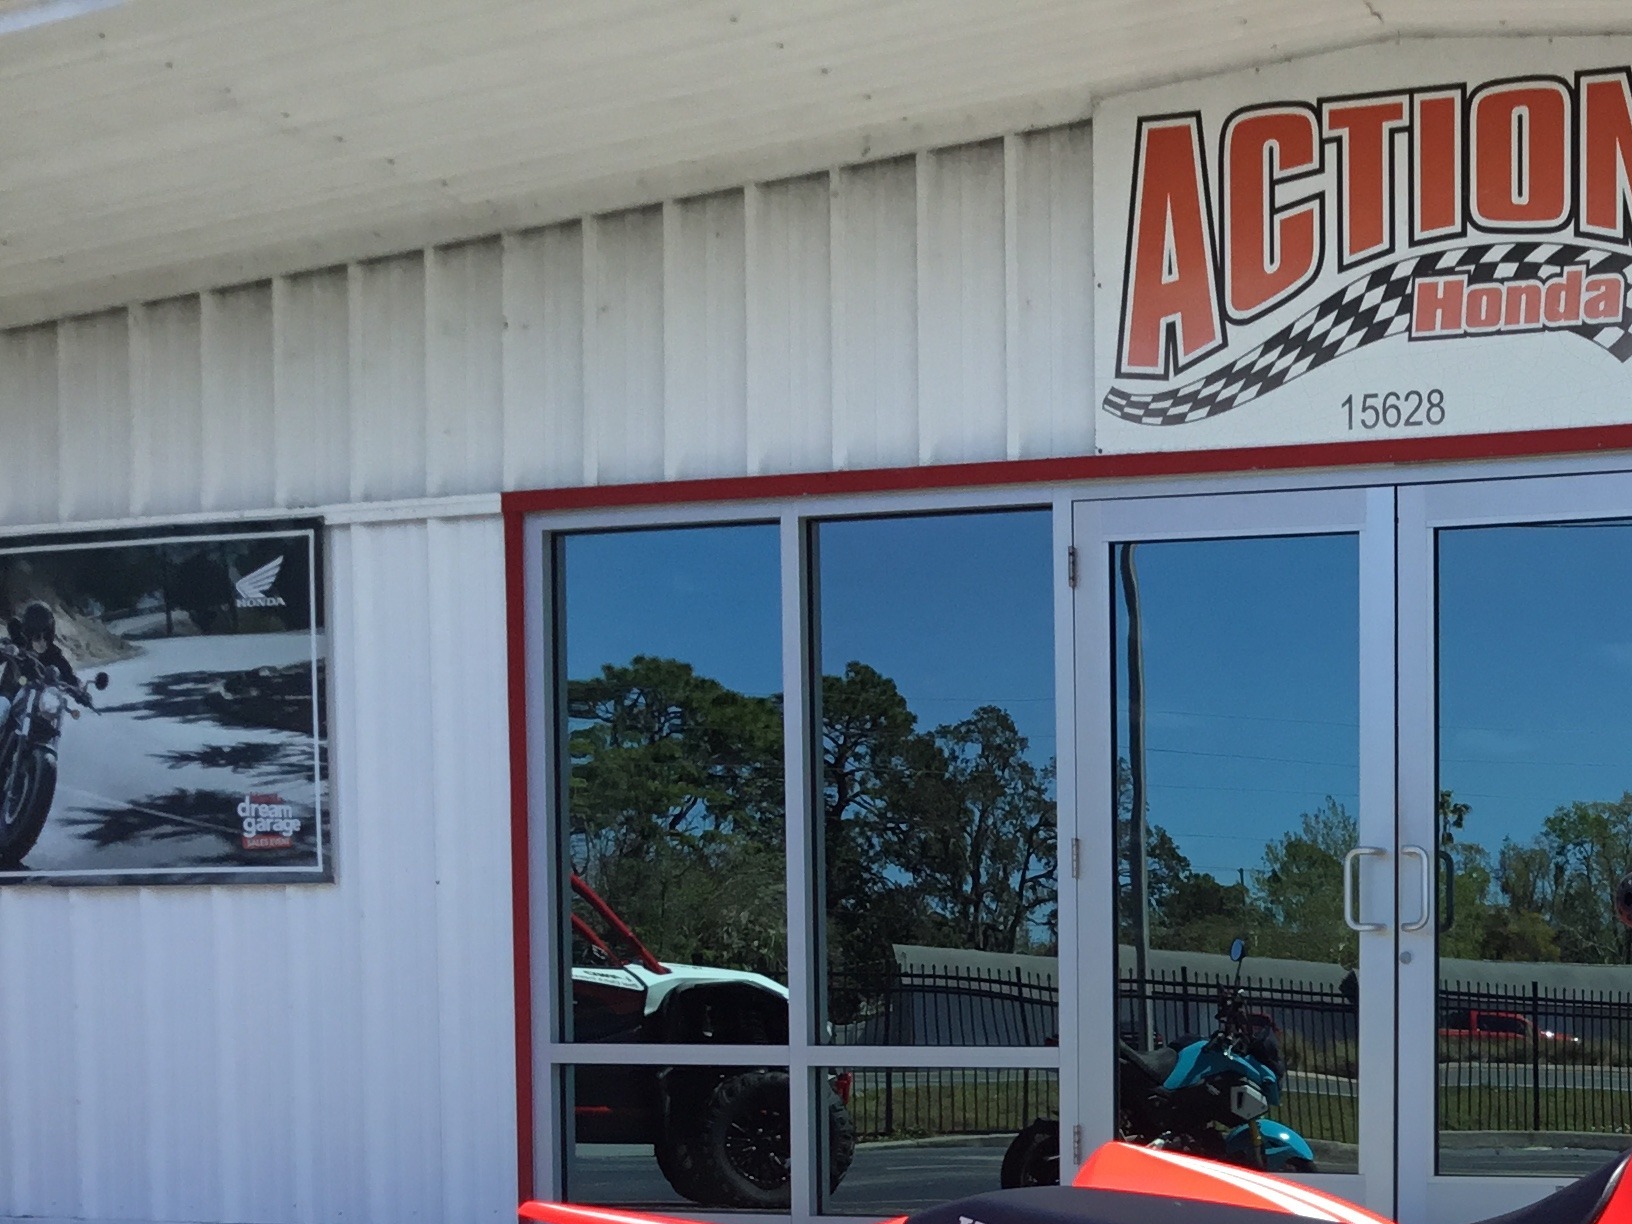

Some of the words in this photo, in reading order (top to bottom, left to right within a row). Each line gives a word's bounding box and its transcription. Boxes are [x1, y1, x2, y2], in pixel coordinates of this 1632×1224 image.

[1409, 262, 1627, 340] Honda
[1341, 389, 1446, 430] 15628
[236, 597, 286, 607] HONDA
[237, 795, 292, 818] dream
[243, 817, 301, 838] garage
